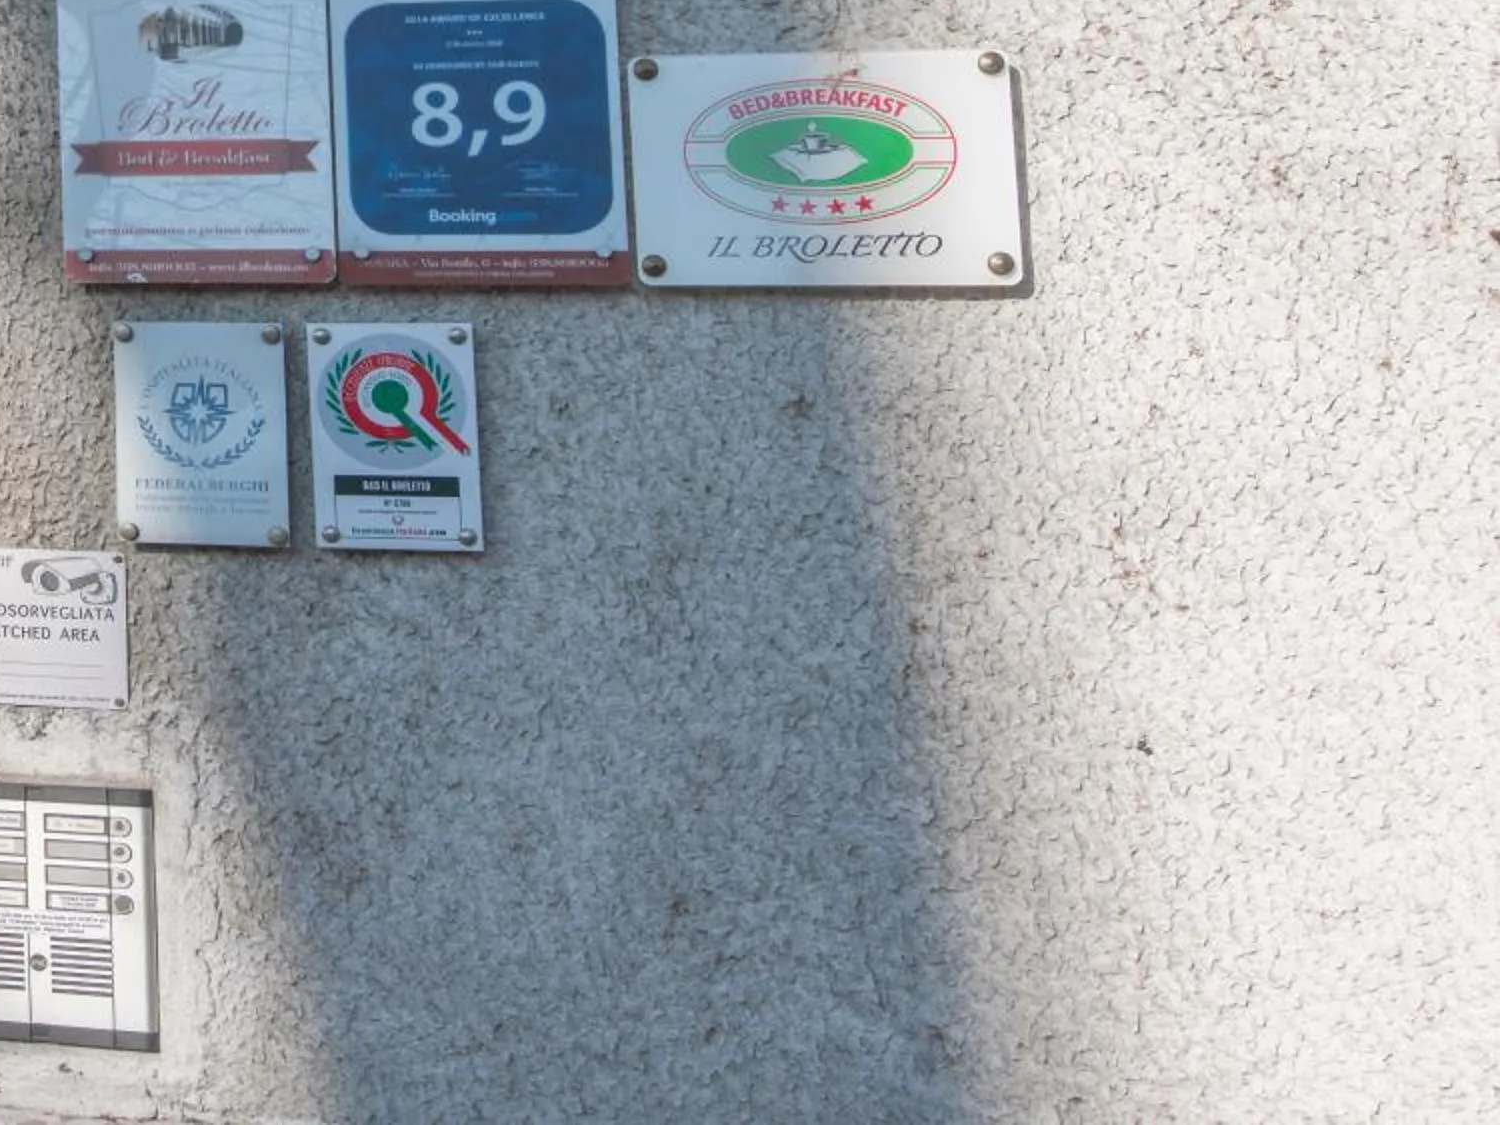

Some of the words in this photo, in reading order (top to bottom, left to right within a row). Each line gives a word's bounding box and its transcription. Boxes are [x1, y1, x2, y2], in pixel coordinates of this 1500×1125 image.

[411, 79, 547, 157] 8,9
[726, 88, 908, 121] BED&BREAKFAST
[429, 208, 496, 226] Booking
[707, 236, 742, 258] IL
[752, 230, 944, 264] BROLETTO
[60, 627, 100, 642] AREA
